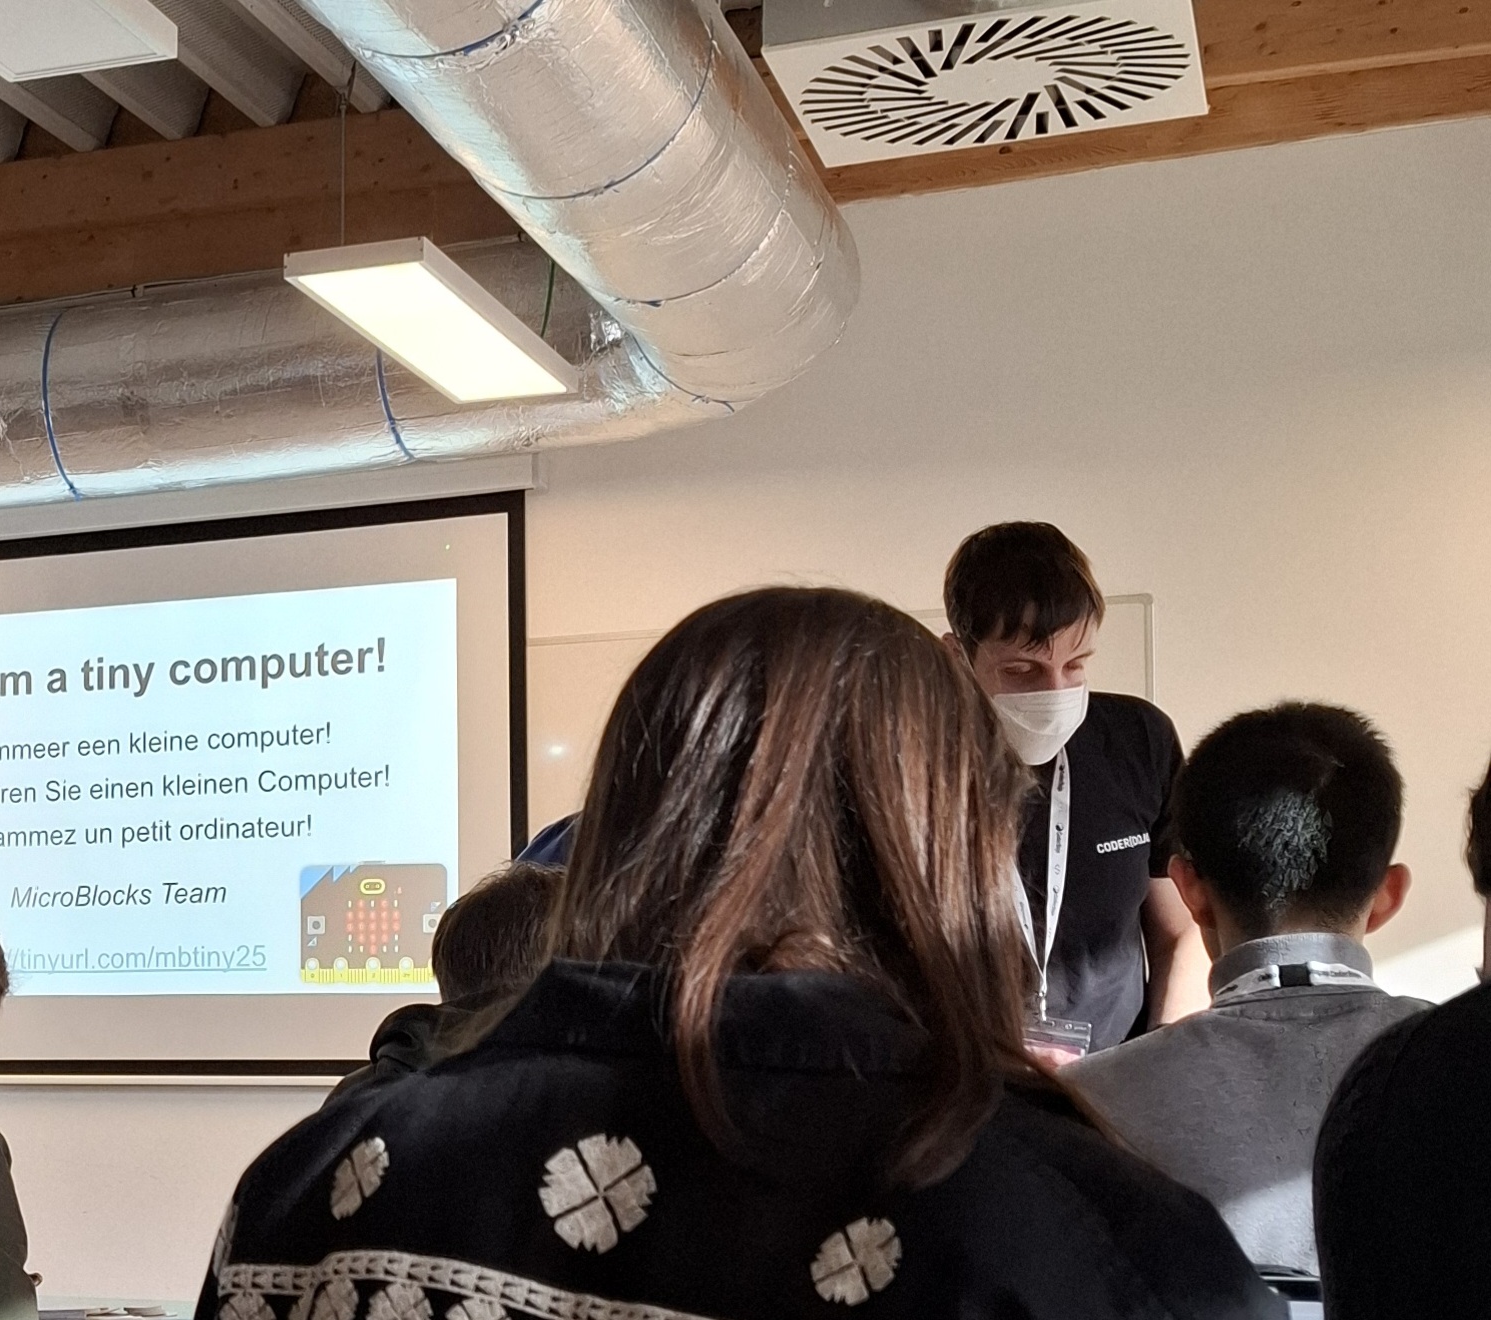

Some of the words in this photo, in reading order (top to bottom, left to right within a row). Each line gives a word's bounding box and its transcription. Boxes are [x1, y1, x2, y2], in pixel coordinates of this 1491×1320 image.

[46, 667, 68, 694] a
[80, 656, 155, 698] tiny
[169, 637, 386, 689] computer!
[77, 737, 121, 757] een
[129, 730, 199, 754] kleine
[207, 721, 331, 753] computer!
[45, 779, 81, 803] Sie
[89, 777, 153, 801] einen
[162, 772, 248, 797] kleinen
[258, 764, 390, 796] Computer!
[84, 826, 113, 845] un
[121, 819, 172, 848] petit
[179, 814, 312, 842] ordinateur!
[10, 883, 152, 908] MicroBlocks
[162, 881, 227, 905] Team
